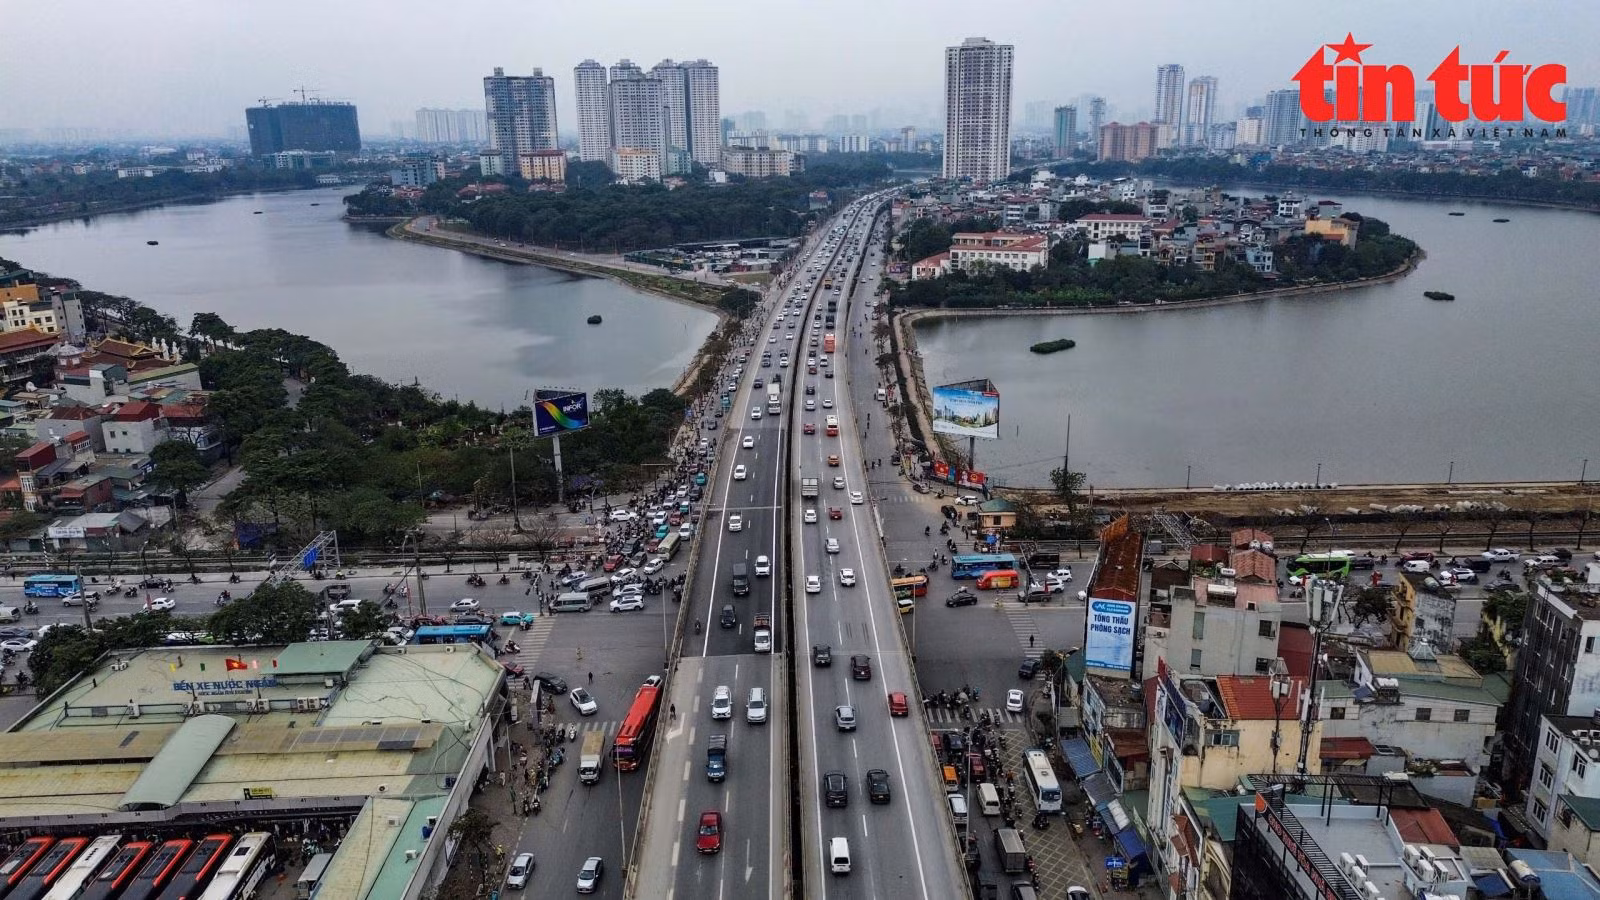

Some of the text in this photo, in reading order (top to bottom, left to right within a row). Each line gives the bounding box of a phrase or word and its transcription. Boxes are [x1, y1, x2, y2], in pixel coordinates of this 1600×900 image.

[1094, 613, 1111, 624] TỔNG
[1090, 623, 1131, 636] PHÒNG SẠCH
[196, 681, 211, 690] XE
